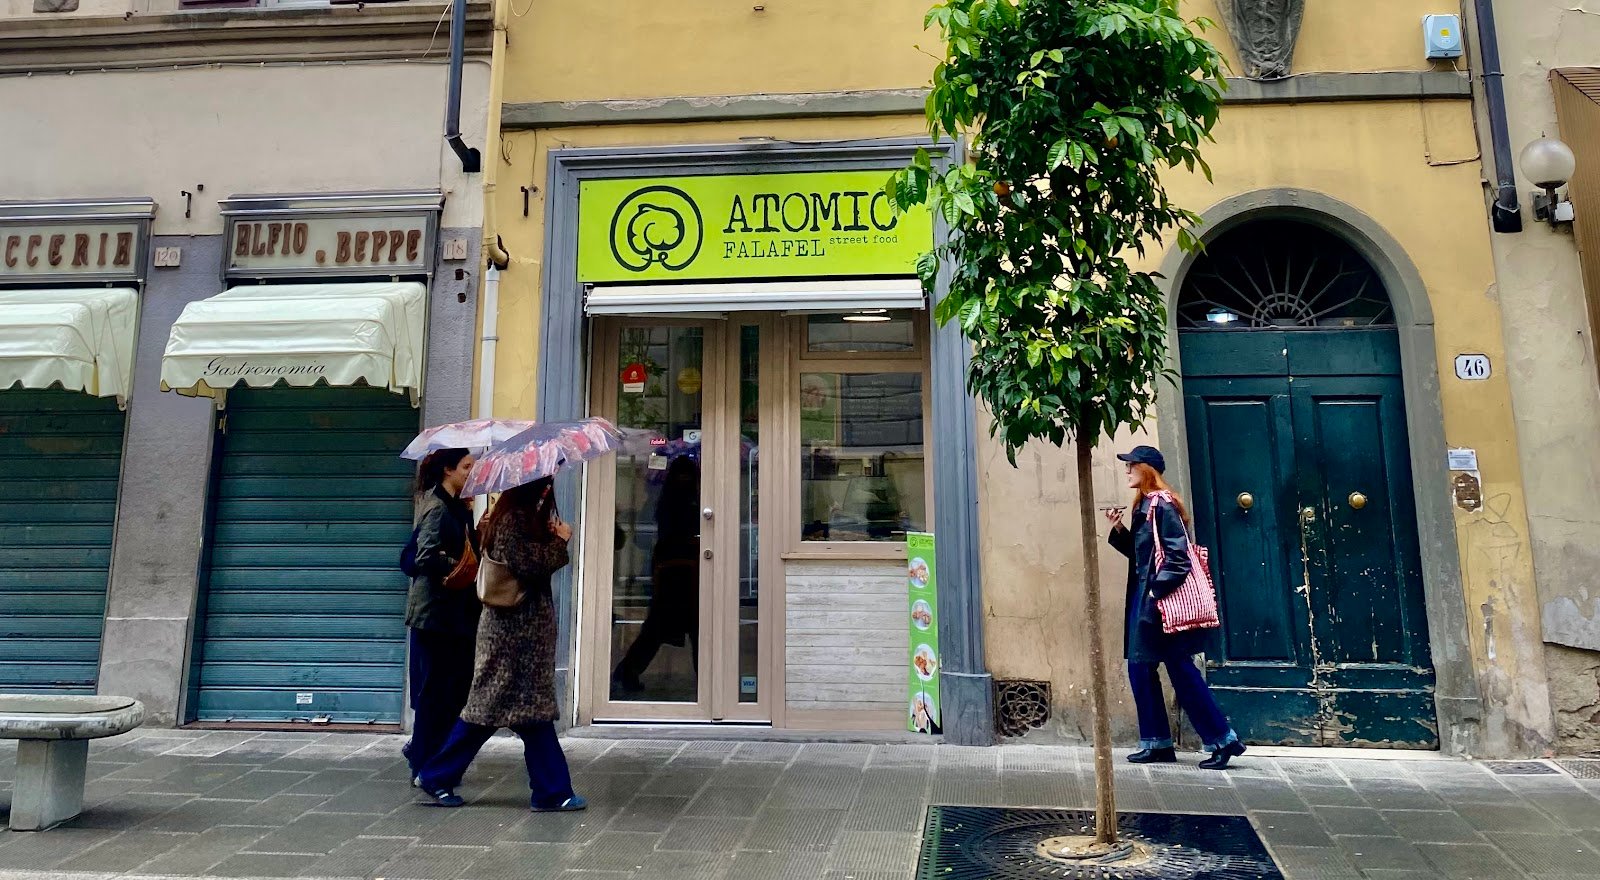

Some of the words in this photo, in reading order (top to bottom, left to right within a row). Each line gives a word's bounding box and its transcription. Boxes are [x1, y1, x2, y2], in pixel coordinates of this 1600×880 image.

[723, 191, 898, 233] ATOMIC
[235, 223, 309, 256] ALFIO
[335, 230, 421, 263] BEPPE
[445, 243, 464, 255] 118
[723, 239, 825, 259] FALAFEL
[829, 235, 868, 245] street
[873, 235, 898, 244] food
[157, 251, 178, 262] 120
[203, 356, 326, 376] Gastronomia
[1464, 359, 1484, 377] 46
